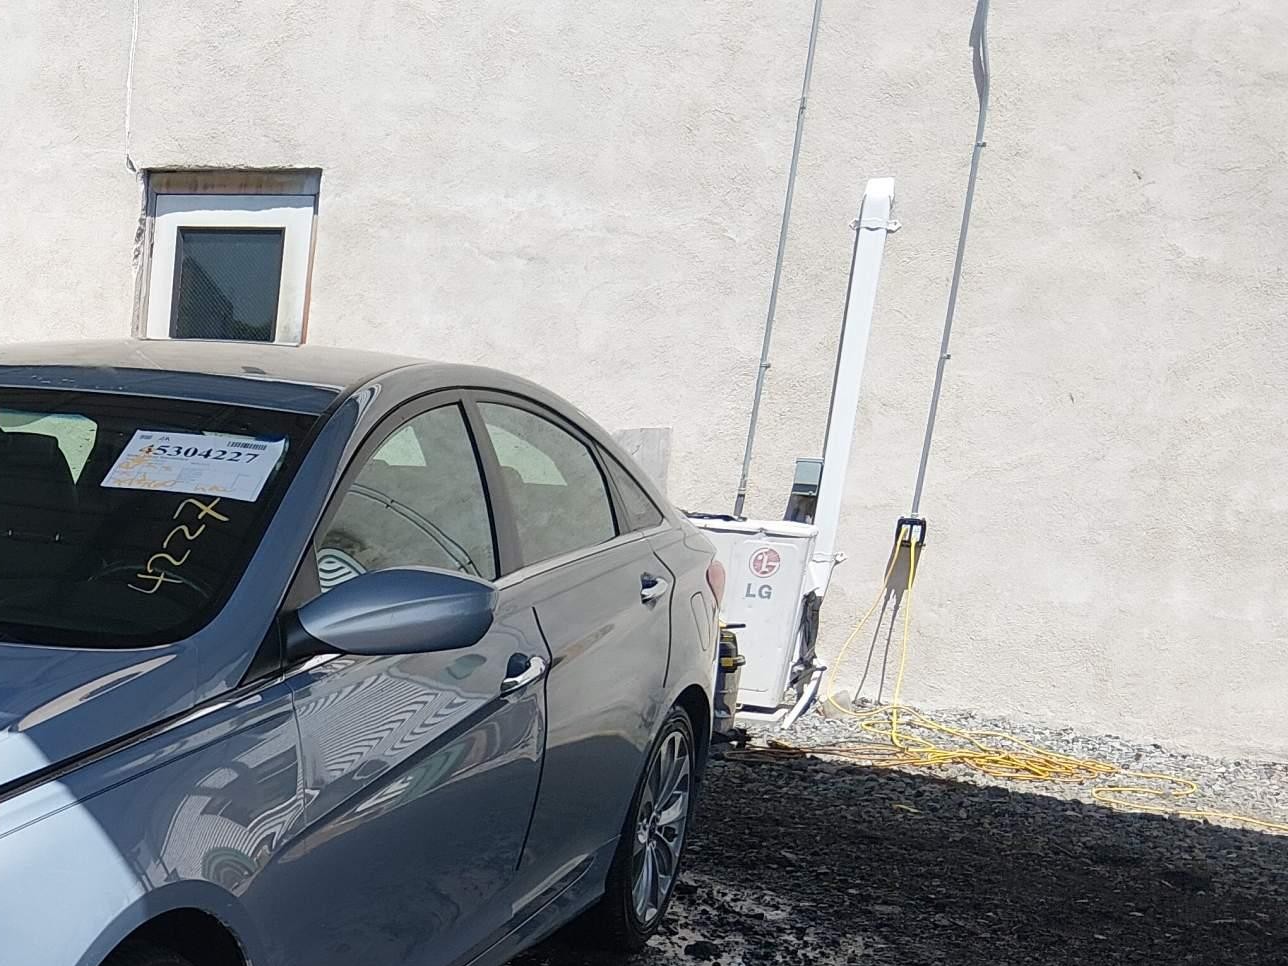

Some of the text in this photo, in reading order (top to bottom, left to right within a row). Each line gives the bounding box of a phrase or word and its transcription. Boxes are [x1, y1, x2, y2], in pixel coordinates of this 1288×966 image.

[139, 444, 261, 464] 45304227
[127, 497, 230, 594] 4227
[745, 583, 773, 600] LG
